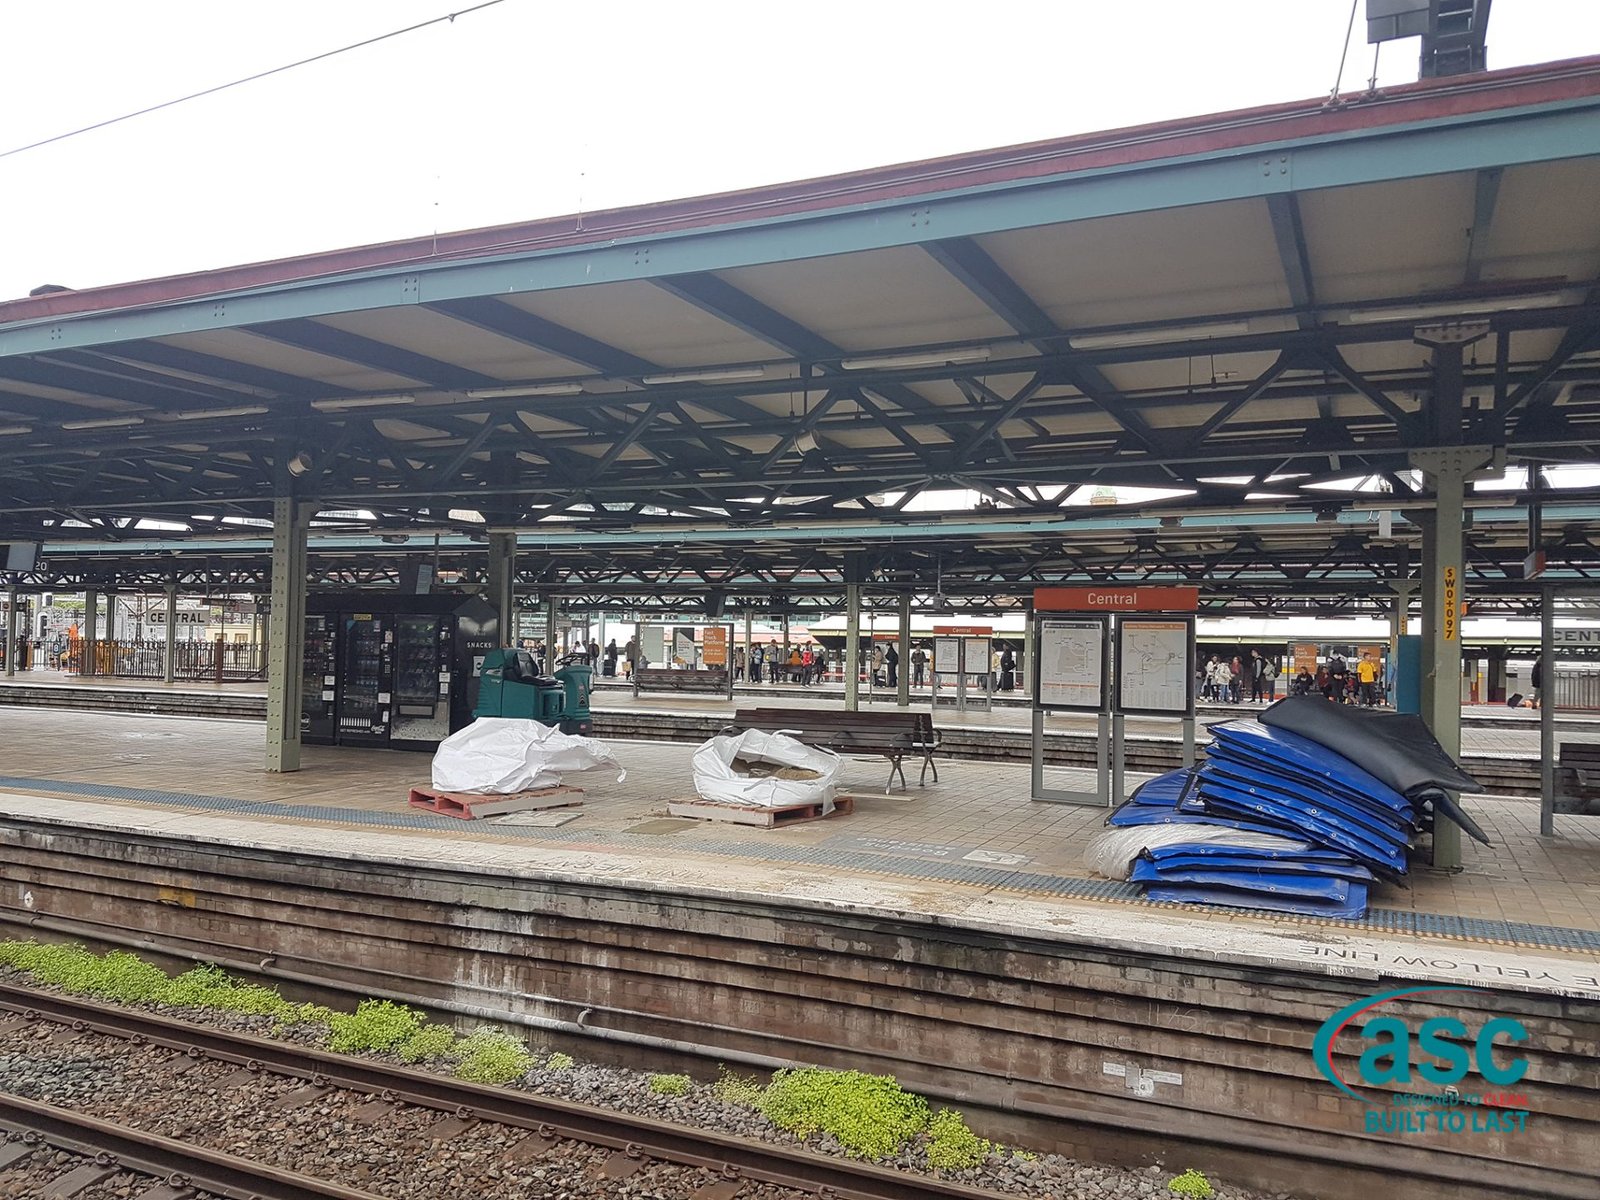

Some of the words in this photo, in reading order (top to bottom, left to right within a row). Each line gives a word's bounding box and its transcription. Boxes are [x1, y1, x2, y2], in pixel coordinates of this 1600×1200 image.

[1087, 592, 1137, 605] Central
[150, 613, 205, 623] CETRAL
[1299, 945, 1379, 962] LINE
[1392, 955, 1561, 983] YELLOW
